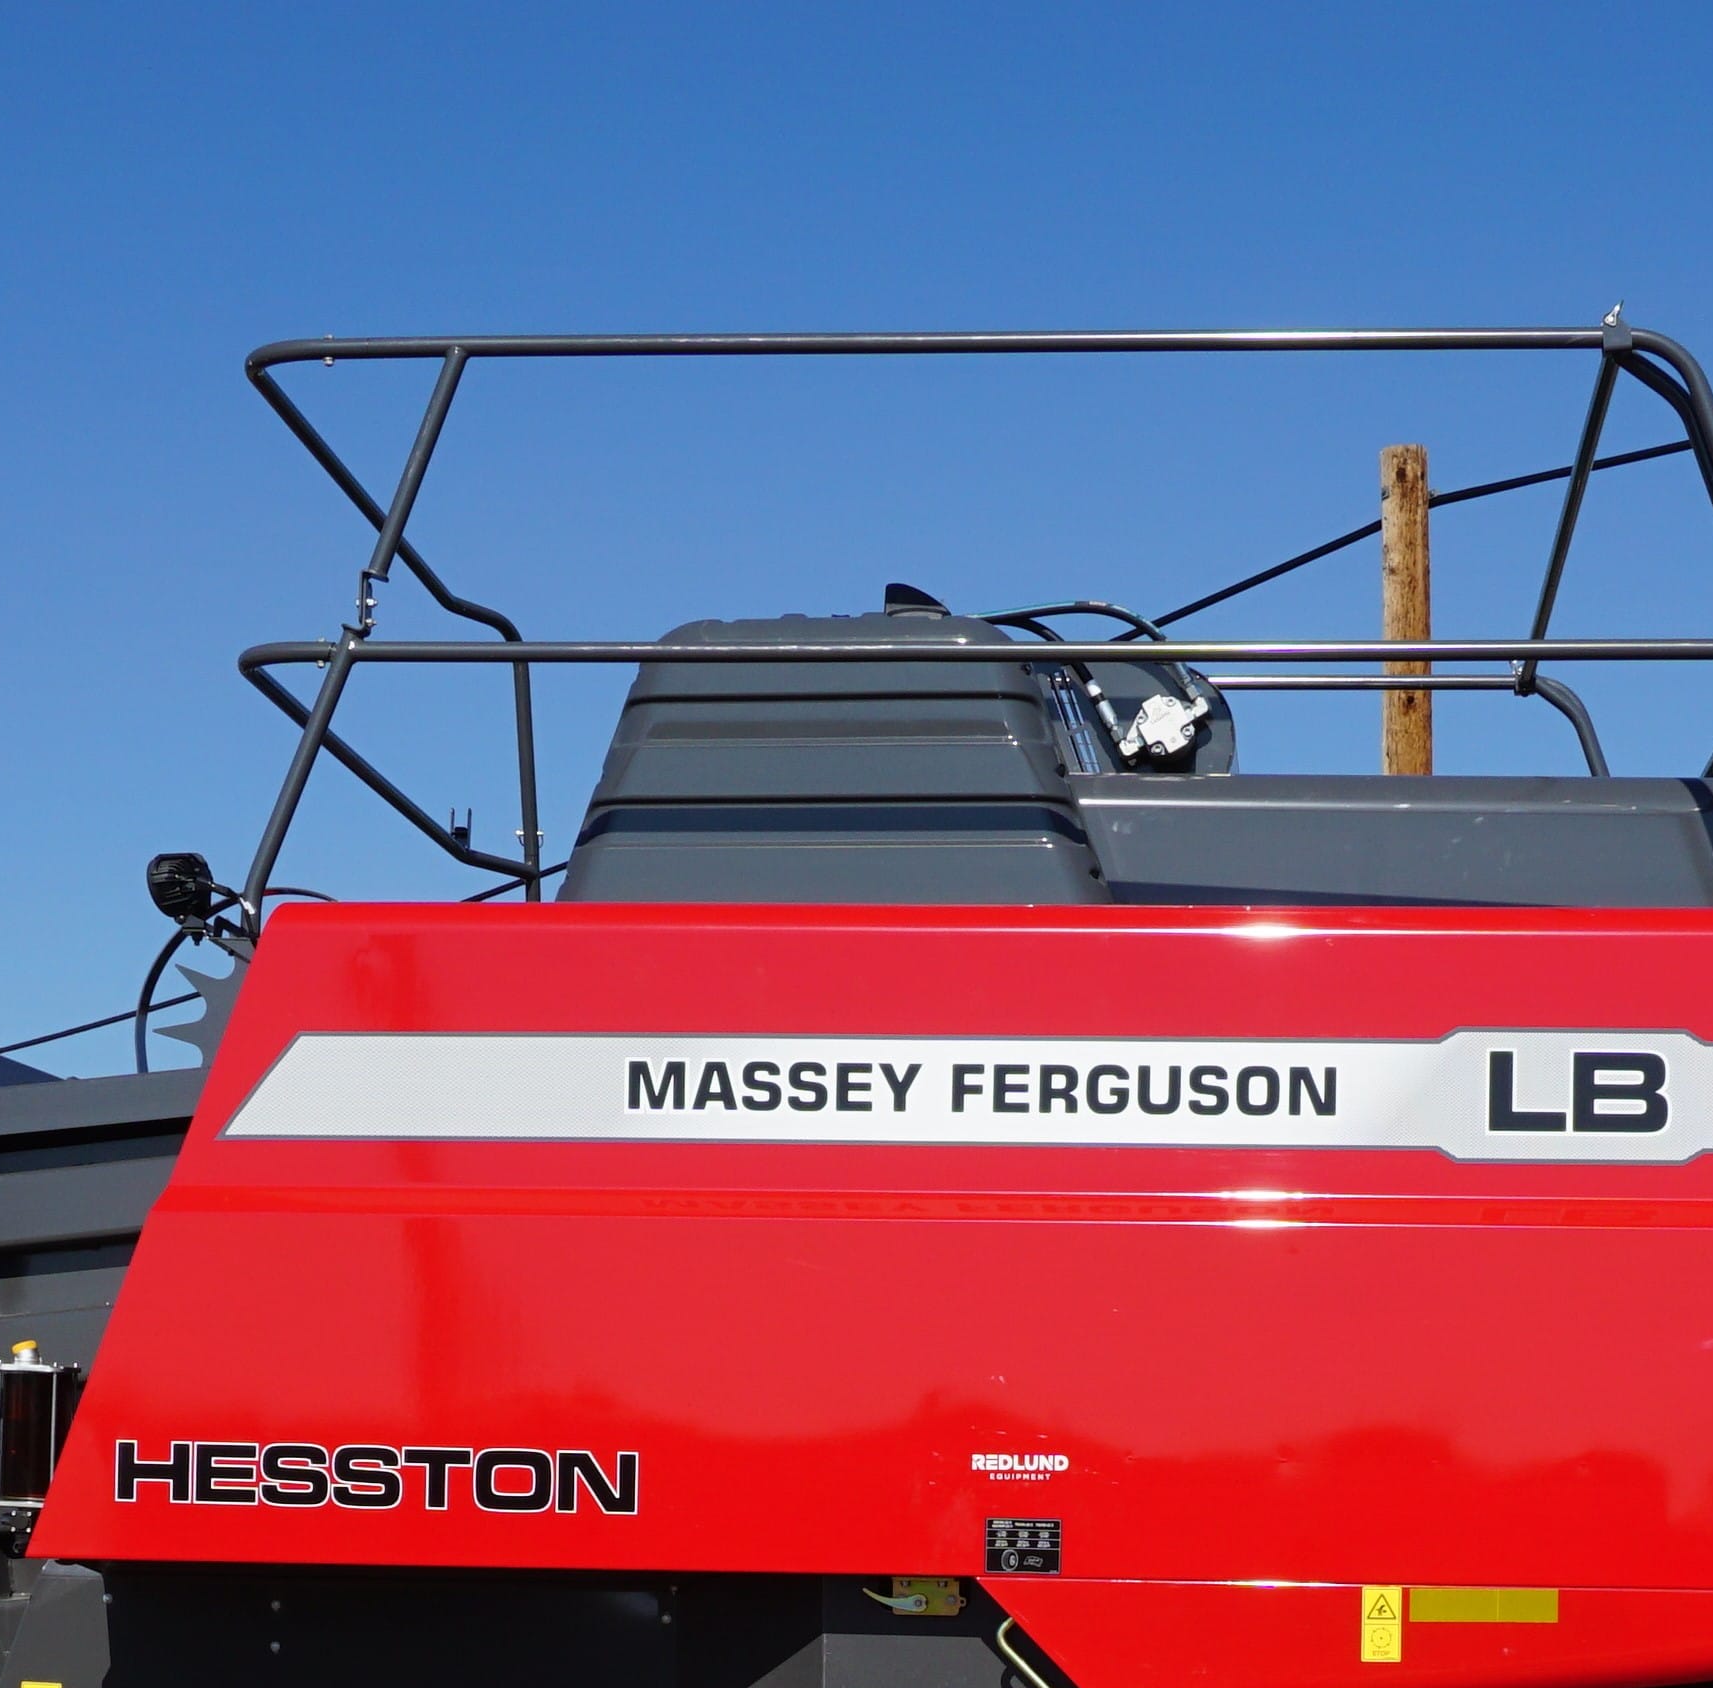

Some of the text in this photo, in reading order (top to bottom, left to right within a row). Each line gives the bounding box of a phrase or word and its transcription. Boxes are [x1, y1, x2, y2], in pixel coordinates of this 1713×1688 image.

[628, 1061, 1337, 1116] MASSEY FERGUSON
[1489, 1051, 1668, 1133] LB
[114, 1439, 641, 1516] HESSTON
[971, 1454, 1069, 1471] REDLUND
[989, 1473, 1051, 1481] EQUIPMENT
